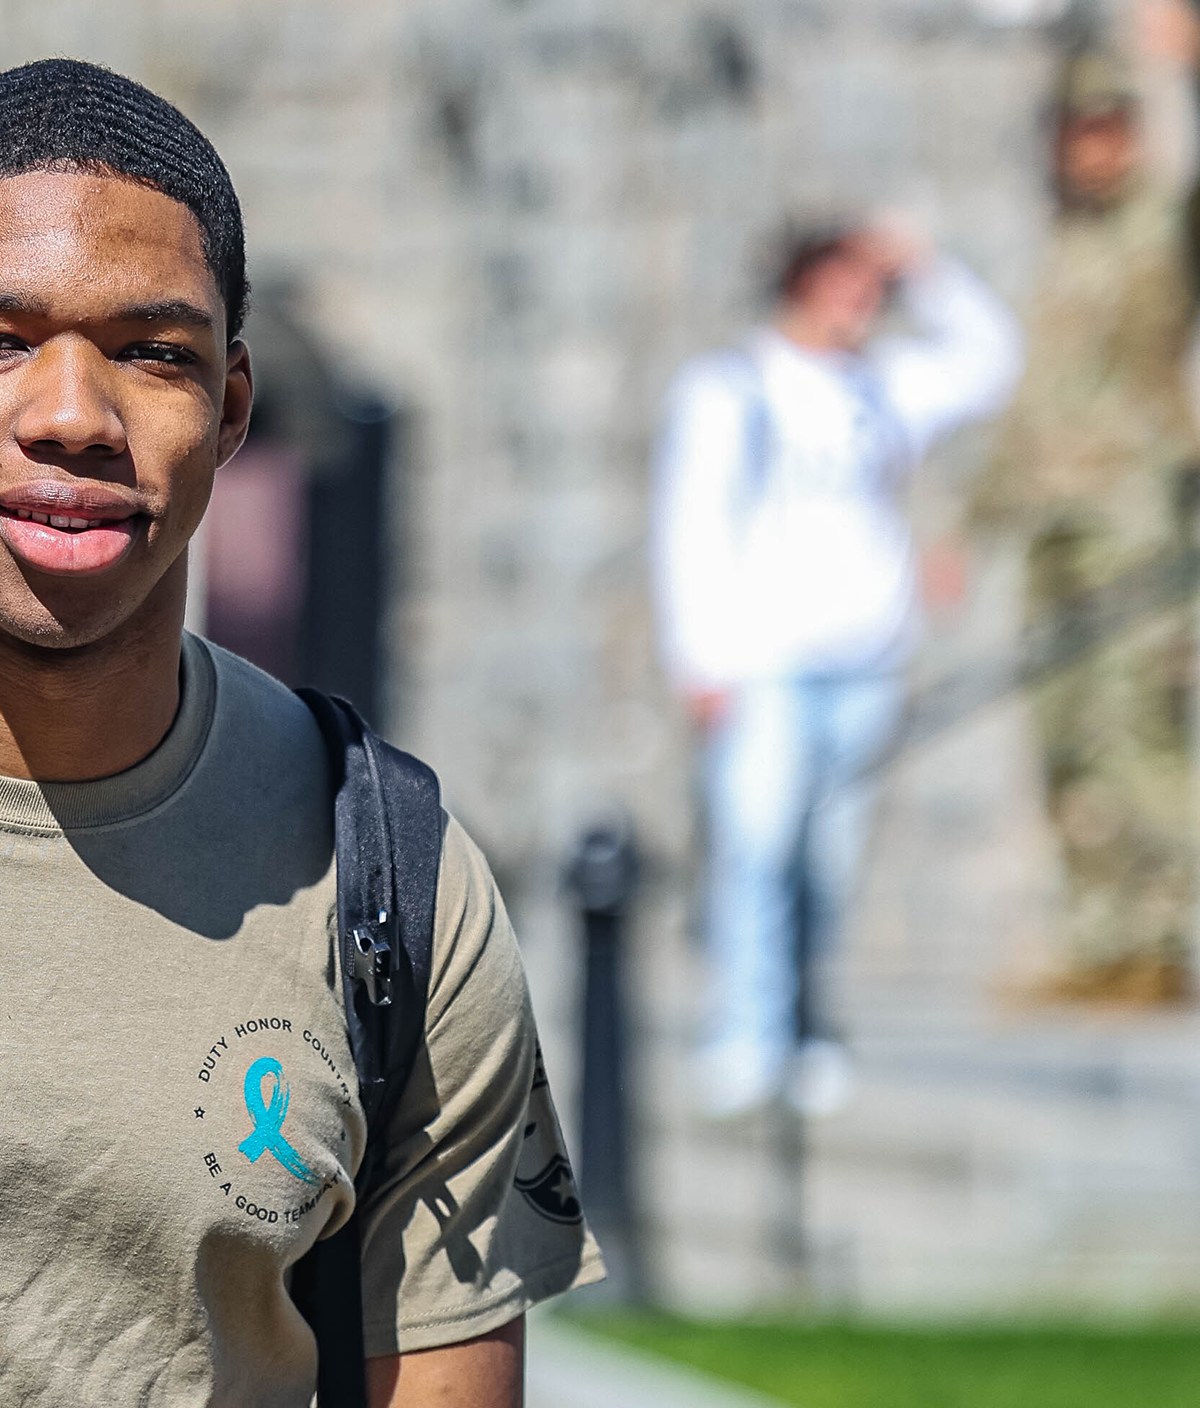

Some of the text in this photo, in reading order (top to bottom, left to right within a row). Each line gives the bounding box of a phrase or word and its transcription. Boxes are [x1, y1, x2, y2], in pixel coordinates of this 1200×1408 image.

[198, 1017, 352, 1108] DUTY HONOR COUNTRY
[203, 1152, 223, 1178] BE
[219, 1182, 232, 1196] A
[234, 1195, 279, 1224] GOOD
